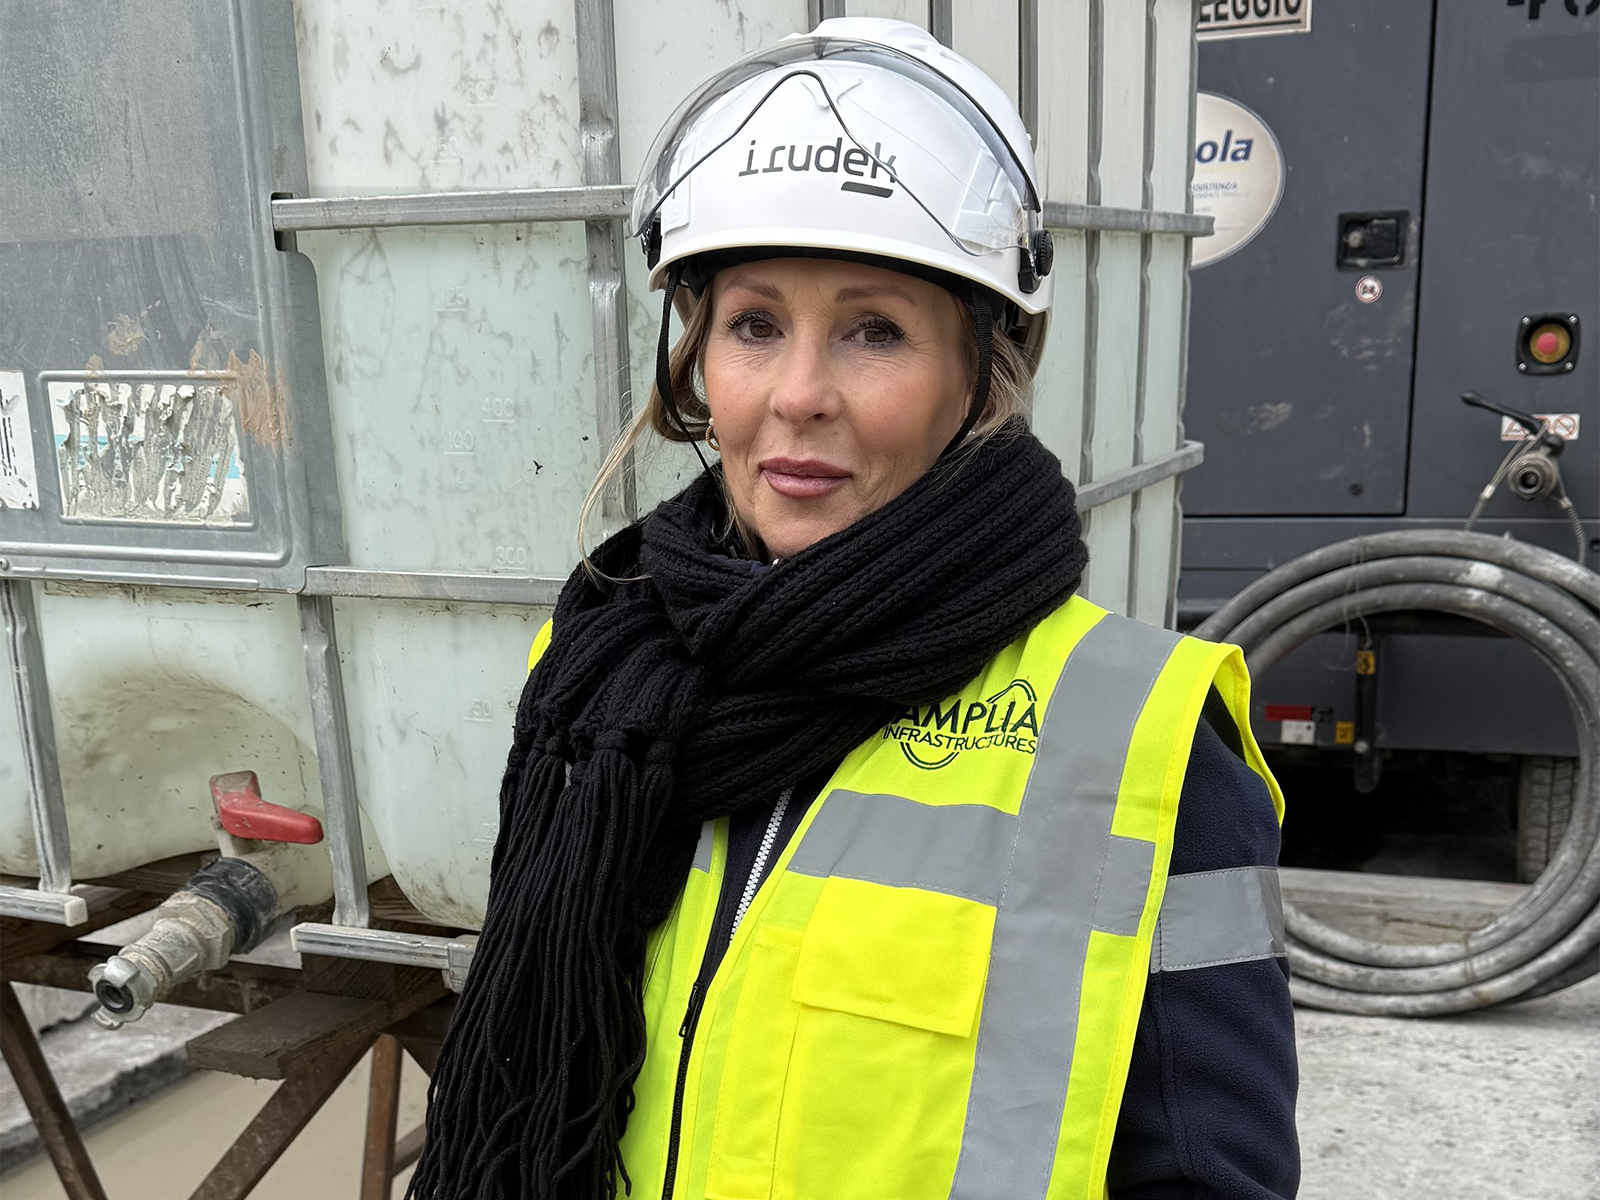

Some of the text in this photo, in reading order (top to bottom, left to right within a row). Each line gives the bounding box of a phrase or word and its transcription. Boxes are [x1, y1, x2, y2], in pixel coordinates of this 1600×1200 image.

[738, 137, 898, 184] irudek
[481, 397, 515, 418] 400
[446, 429, 475, 450] 100
[495, 545, 527, 565] 300
[470, 698, 492, 716] 50
[891, 699, 1039, 737] AMPLIA
[882, 724, 1037, 755] INFRASTRUCTURES
